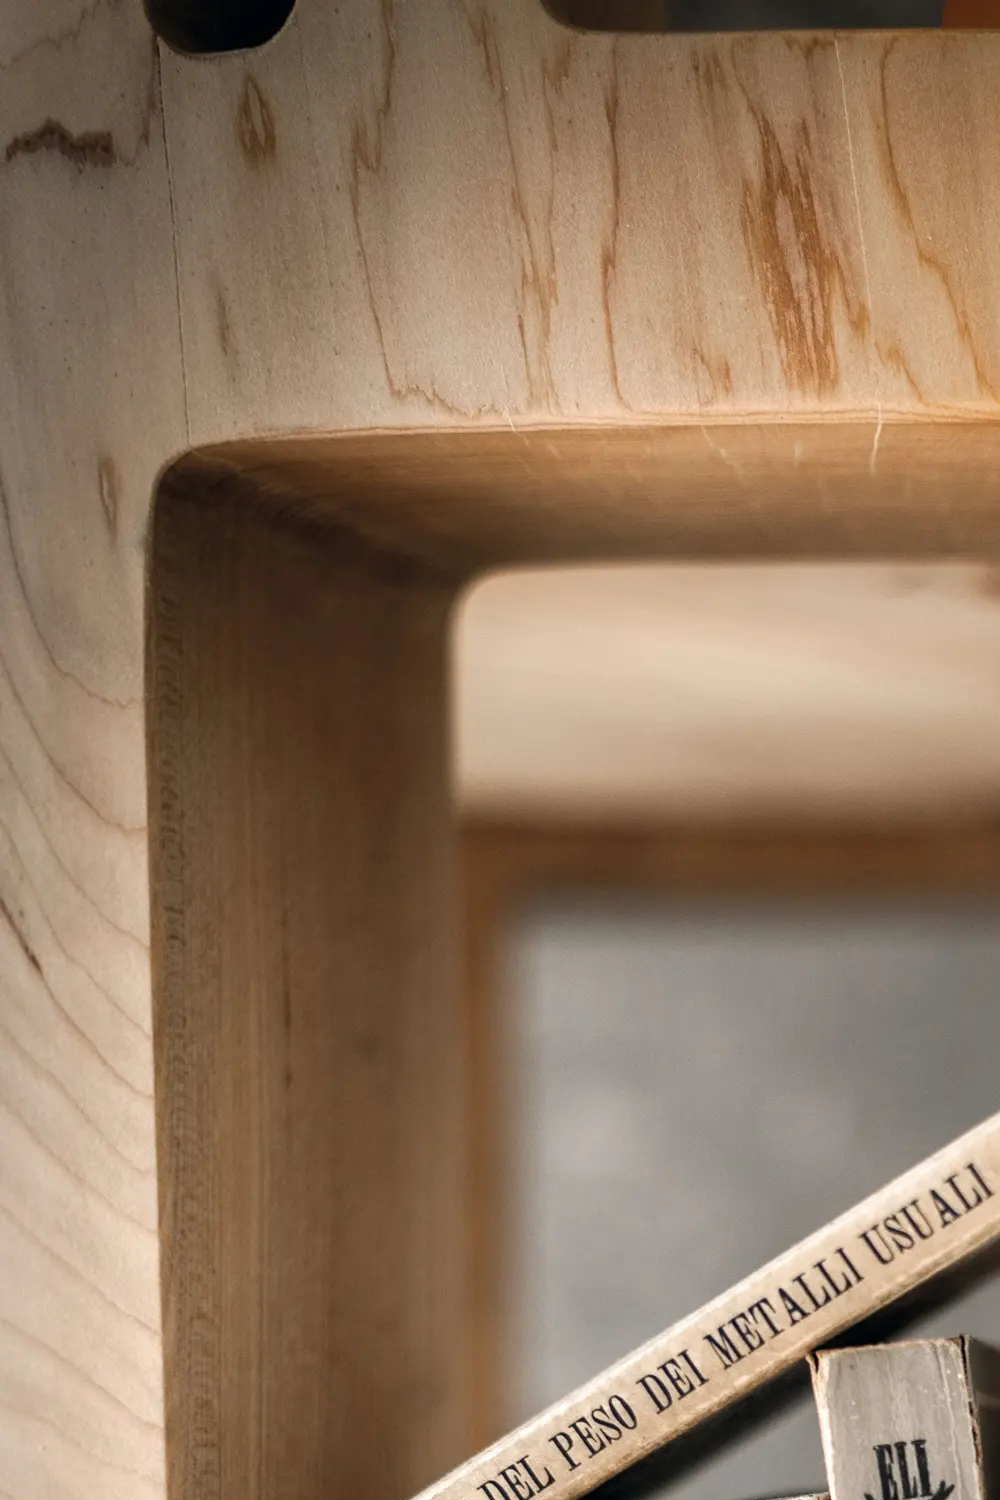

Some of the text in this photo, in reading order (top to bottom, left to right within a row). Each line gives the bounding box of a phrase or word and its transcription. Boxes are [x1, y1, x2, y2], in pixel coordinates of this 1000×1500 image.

[548, 1394, 638, 1472] PESO
[635, 1349, 709, 1415] DEI
[703, 1247, 864, 1370] METALLI
[859, 1162, 995, 1266] USUALI
